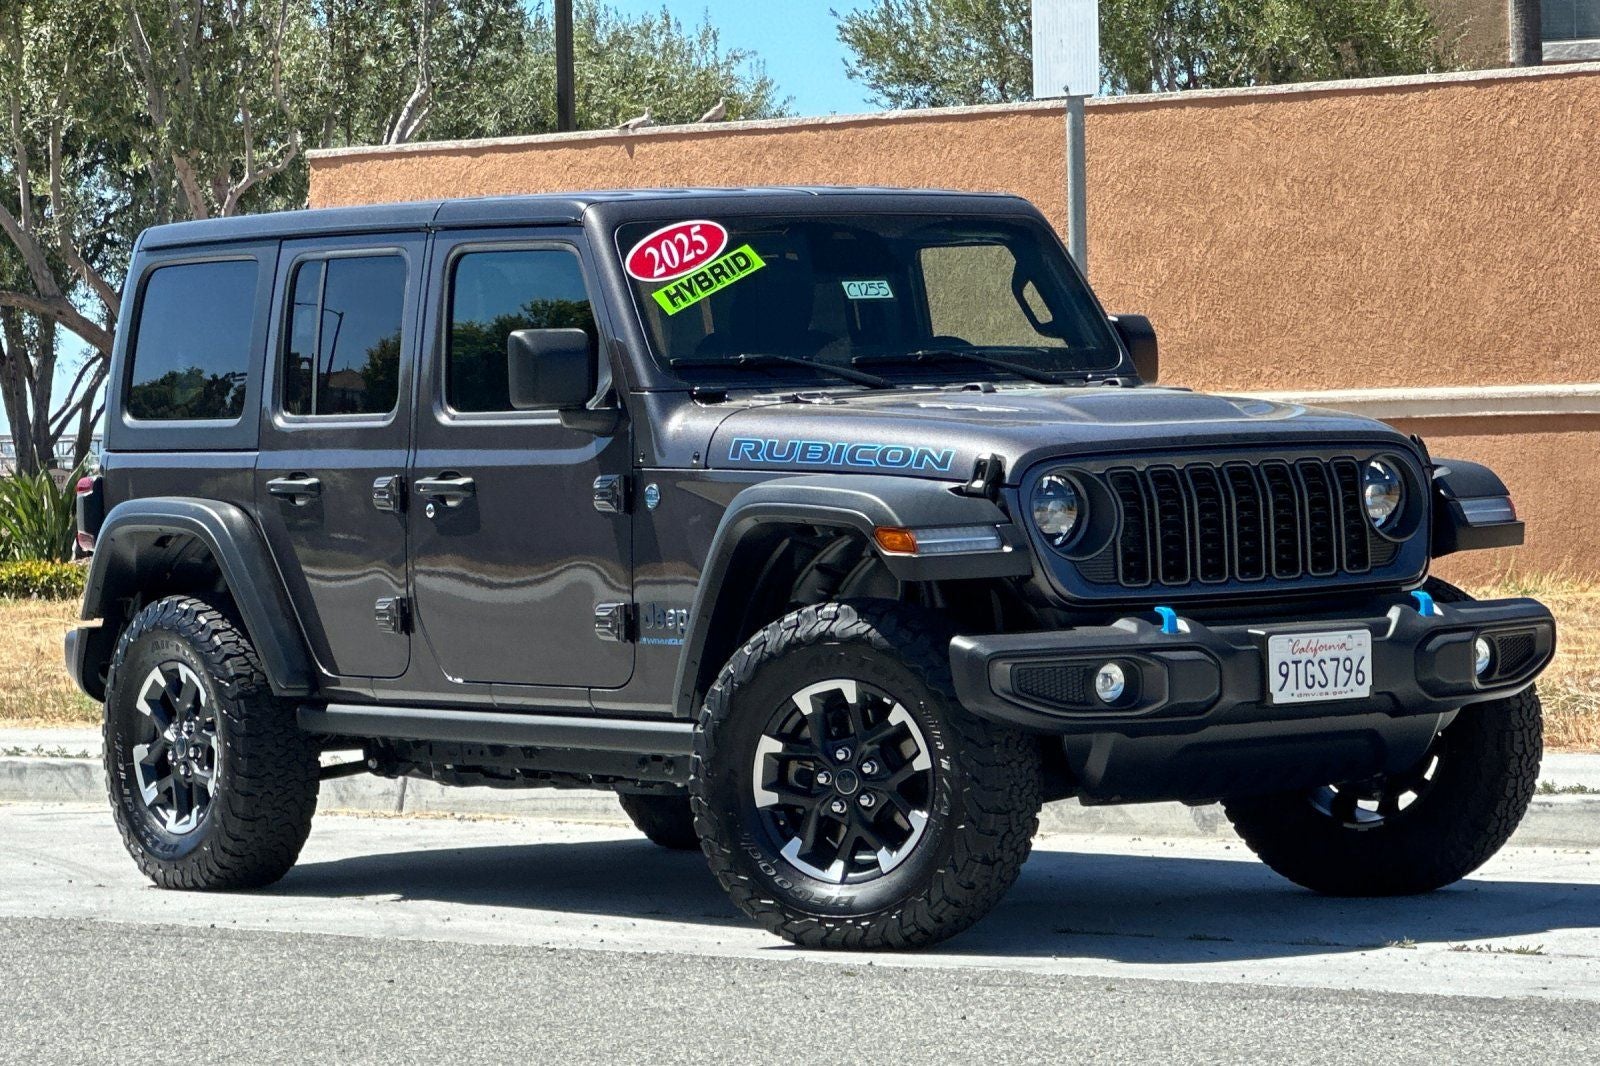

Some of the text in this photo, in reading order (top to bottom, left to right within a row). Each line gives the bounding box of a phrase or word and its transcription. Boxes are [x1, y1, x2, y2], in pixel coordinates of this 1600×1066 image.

[645, 225, 708, 277] 2025
[663, 250, 753, 308] HYBRID
[847, 282, 890, 297] C1255
[729, 437, 956, 471] RUBICON
[645, 602, 689, 635] Jeep
[1292, 639, 1353, 658] California
[1278, 656, 1366, 692] 9TGS796
